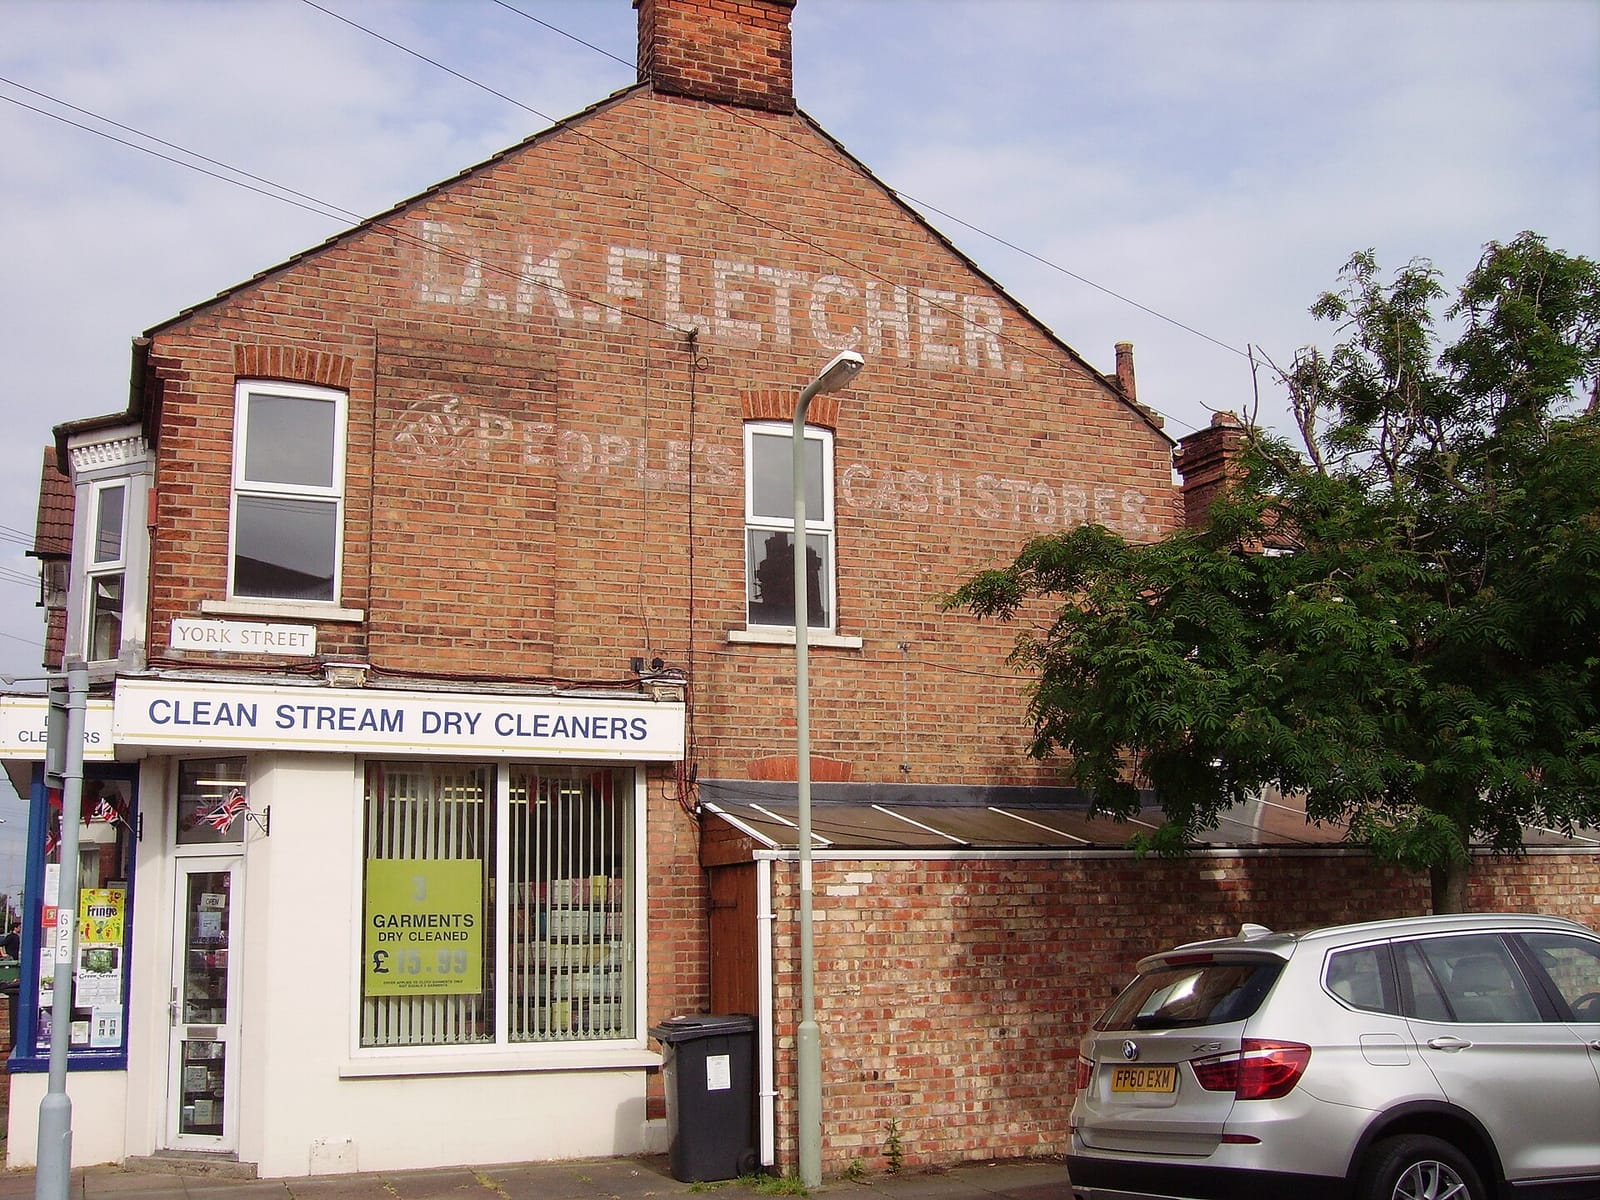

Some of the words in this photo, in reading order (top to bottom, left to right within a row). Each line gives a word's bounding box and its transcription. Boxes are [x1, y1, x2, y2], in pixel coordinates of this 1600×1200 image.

[842, 463, 961, 516] CASH
[178, 626, 232, 644] YORK
[240, 630, 310, 648] STREET
[149, 699, 258, 728] CLEAN
[275, 704, 404, 733] STREAM
[421, 711, 482, 735] DRY
[494, 713, 648, 741] CLEANERS
[18, 730, 101, 744] CLERS
[205, 898, 220, 906] OPEN
[87, 905, 118, 918] Fringe
[373, 914, 475, 928] GARMENTS
[378, 932, 403, 942] DRY
[408, 931, 469, 942] CLEANED
[1191, 1041, 1222, 1053] X3
[1116, 1070, 1145, 1088] FP60
[1147, 1069, 1170, 1088] EXM
